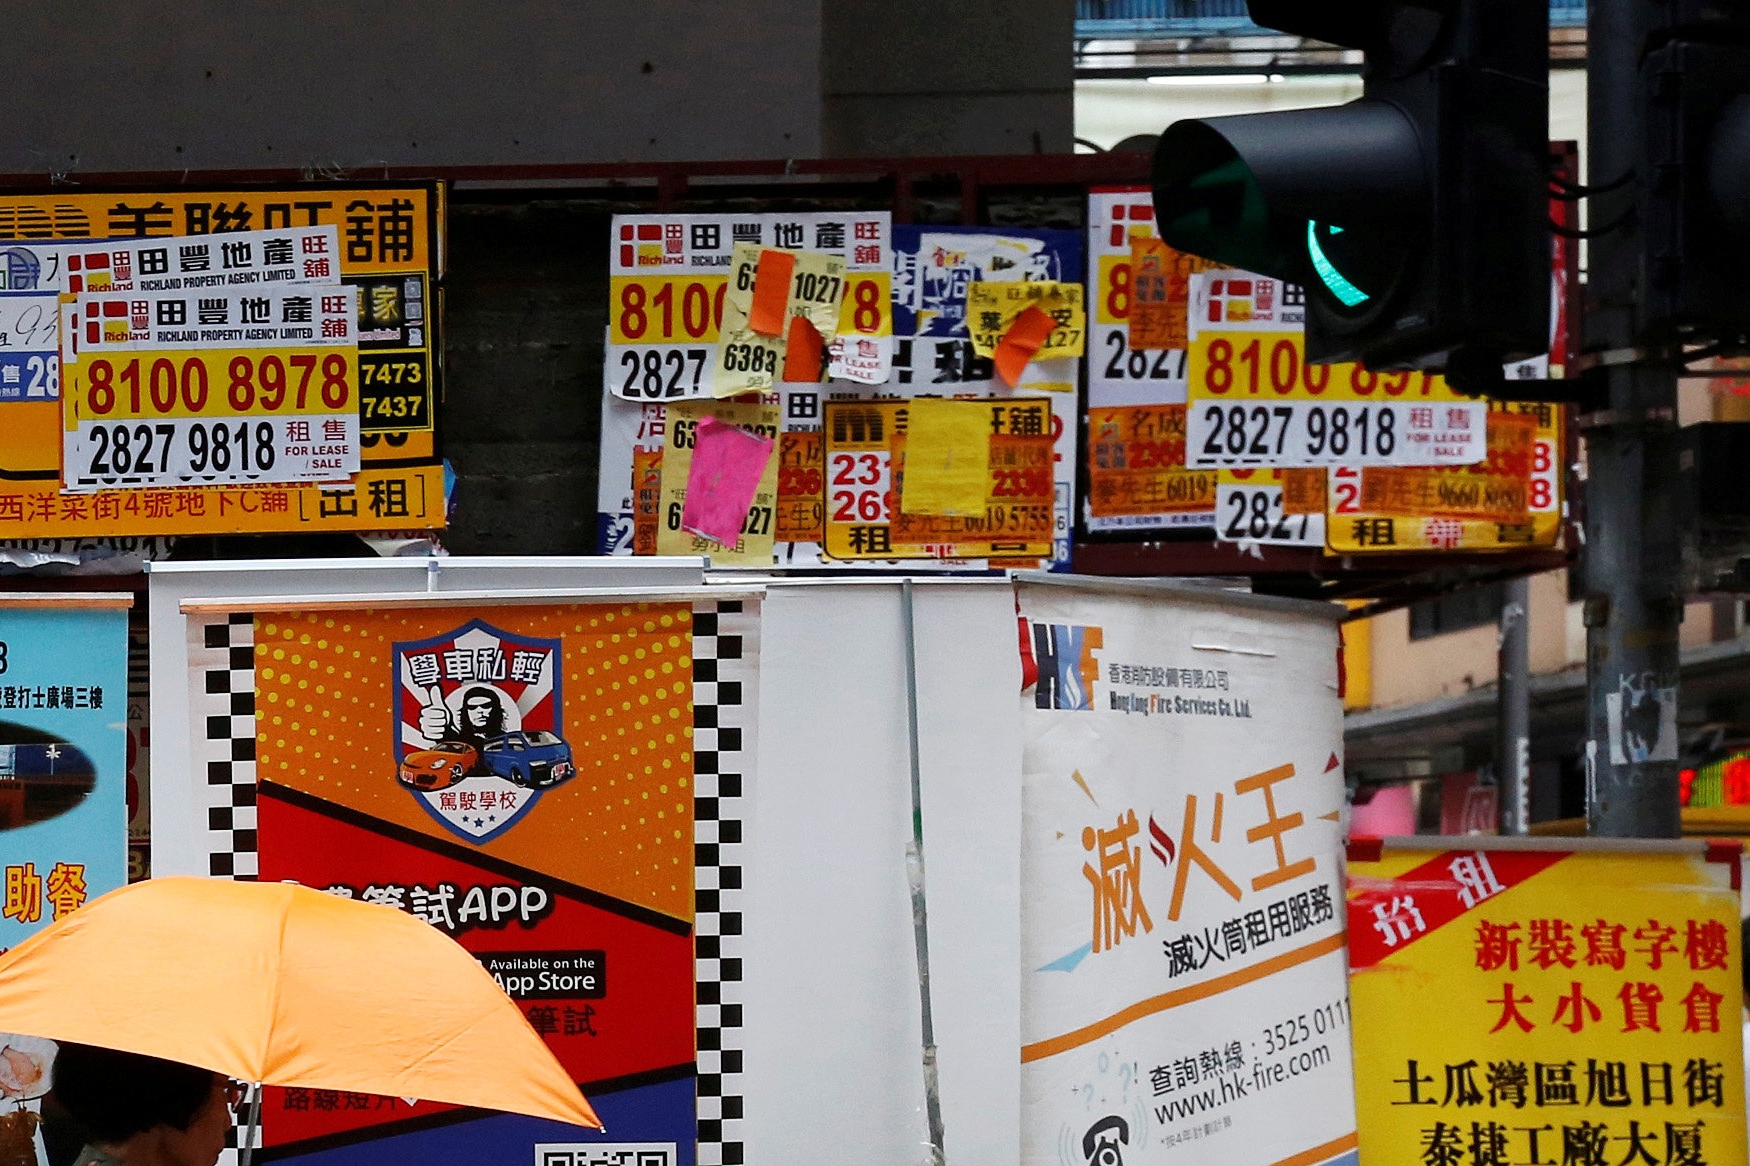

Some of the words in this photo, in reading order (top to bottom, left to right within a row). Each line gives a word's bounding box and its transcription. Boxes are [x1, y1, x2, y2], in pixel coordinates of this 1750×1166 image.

[137, 238, 295, 275] 田豐地產
[795, 272, 840, 304] 1027
[156, 296, 313, 326] 田豐地產
[157, 330, 199, 343] RICHLAND
[201, 329, 243, 342] PROPERTY
[245, 328, 278, 341] AGENCY
[279, 327, 313, 340] LIMITED
[87, 356, 209, 415] 8100
[227, 353, 349, 412] 8978
[361, 362, 422, 386] 7473
[621, 349, 707, 398] 2827
[362, 395, 423, 418] 7437
[89, 423, 176, 475] 2827
[188, 420, 276, 472] 9818
[285, 446, 308, 456] FOR
[312, 445, 350, 455] LEASE
[1202, 406, 1294, 455] 2827
[1307, 406, 1396, 455] 9818
[408, 647, 546, 687] 學車私輕
[439, 790, 518, 812] 駕駛學校
[1081, 762, 1318, 954] 滅火王
[1162, 884, 1335, 979] 滅火筒租用服務
[1473, 918, 1730, 972] 新裝寫字樓
[489, 958, 549, 971] Available
[537, 970, 596, 992] Store
[1486, 981, 1725, 1035] 大小貨倉
[1262, 1015, 1311, 1057] 3525
[1154, 1042, 1332, 1126] www.hk-fire.com
[1391, 1059, 1726, 1109] 土瓜灣區旭日街
